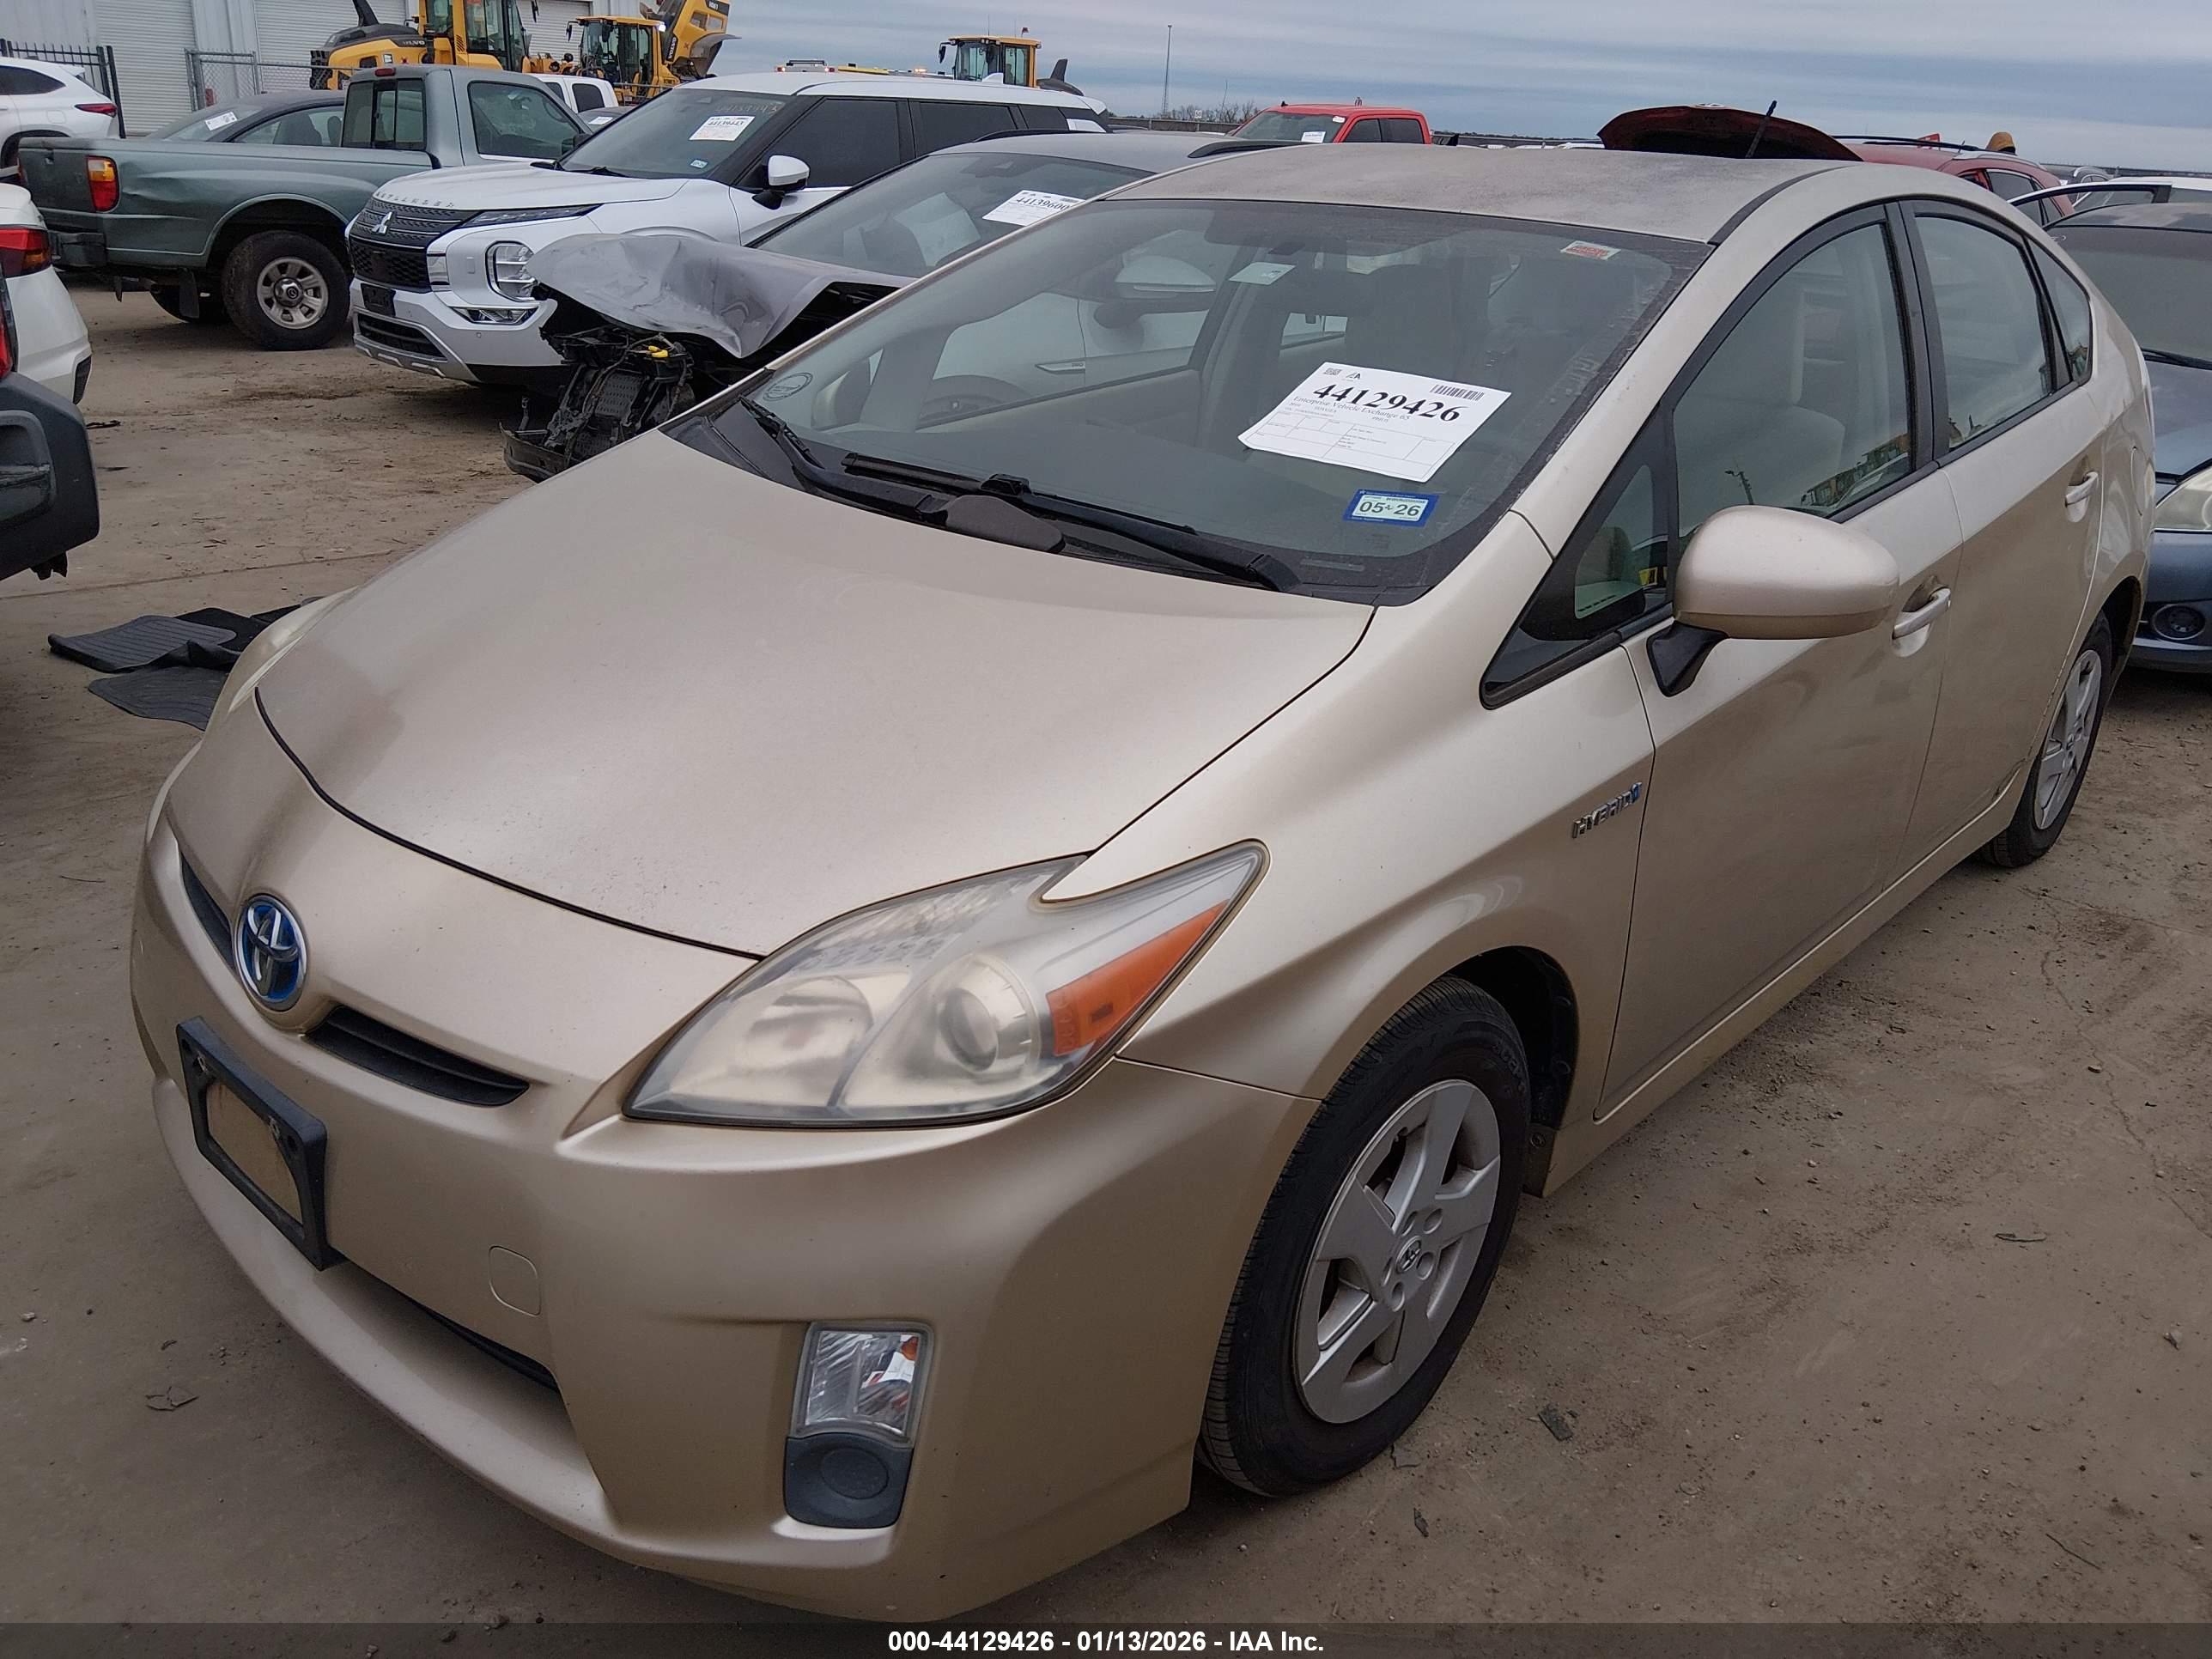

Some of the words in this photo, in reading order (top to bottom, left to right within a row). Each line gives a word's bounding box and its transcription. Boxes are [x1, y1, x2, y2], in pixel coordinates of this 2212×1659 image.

[668, 36, 677, 59] VOLVO
[1293, 396, 1331, 407] Enterprise
[1333, 402, 1360, 412] Vehicle
[1361, 407, 1399, 419] Exchange
[1313, 384, 1469, 422] 44129426
[1359, 501, 1386, 514] 05
[1393, 504, 1421, 517] 26
